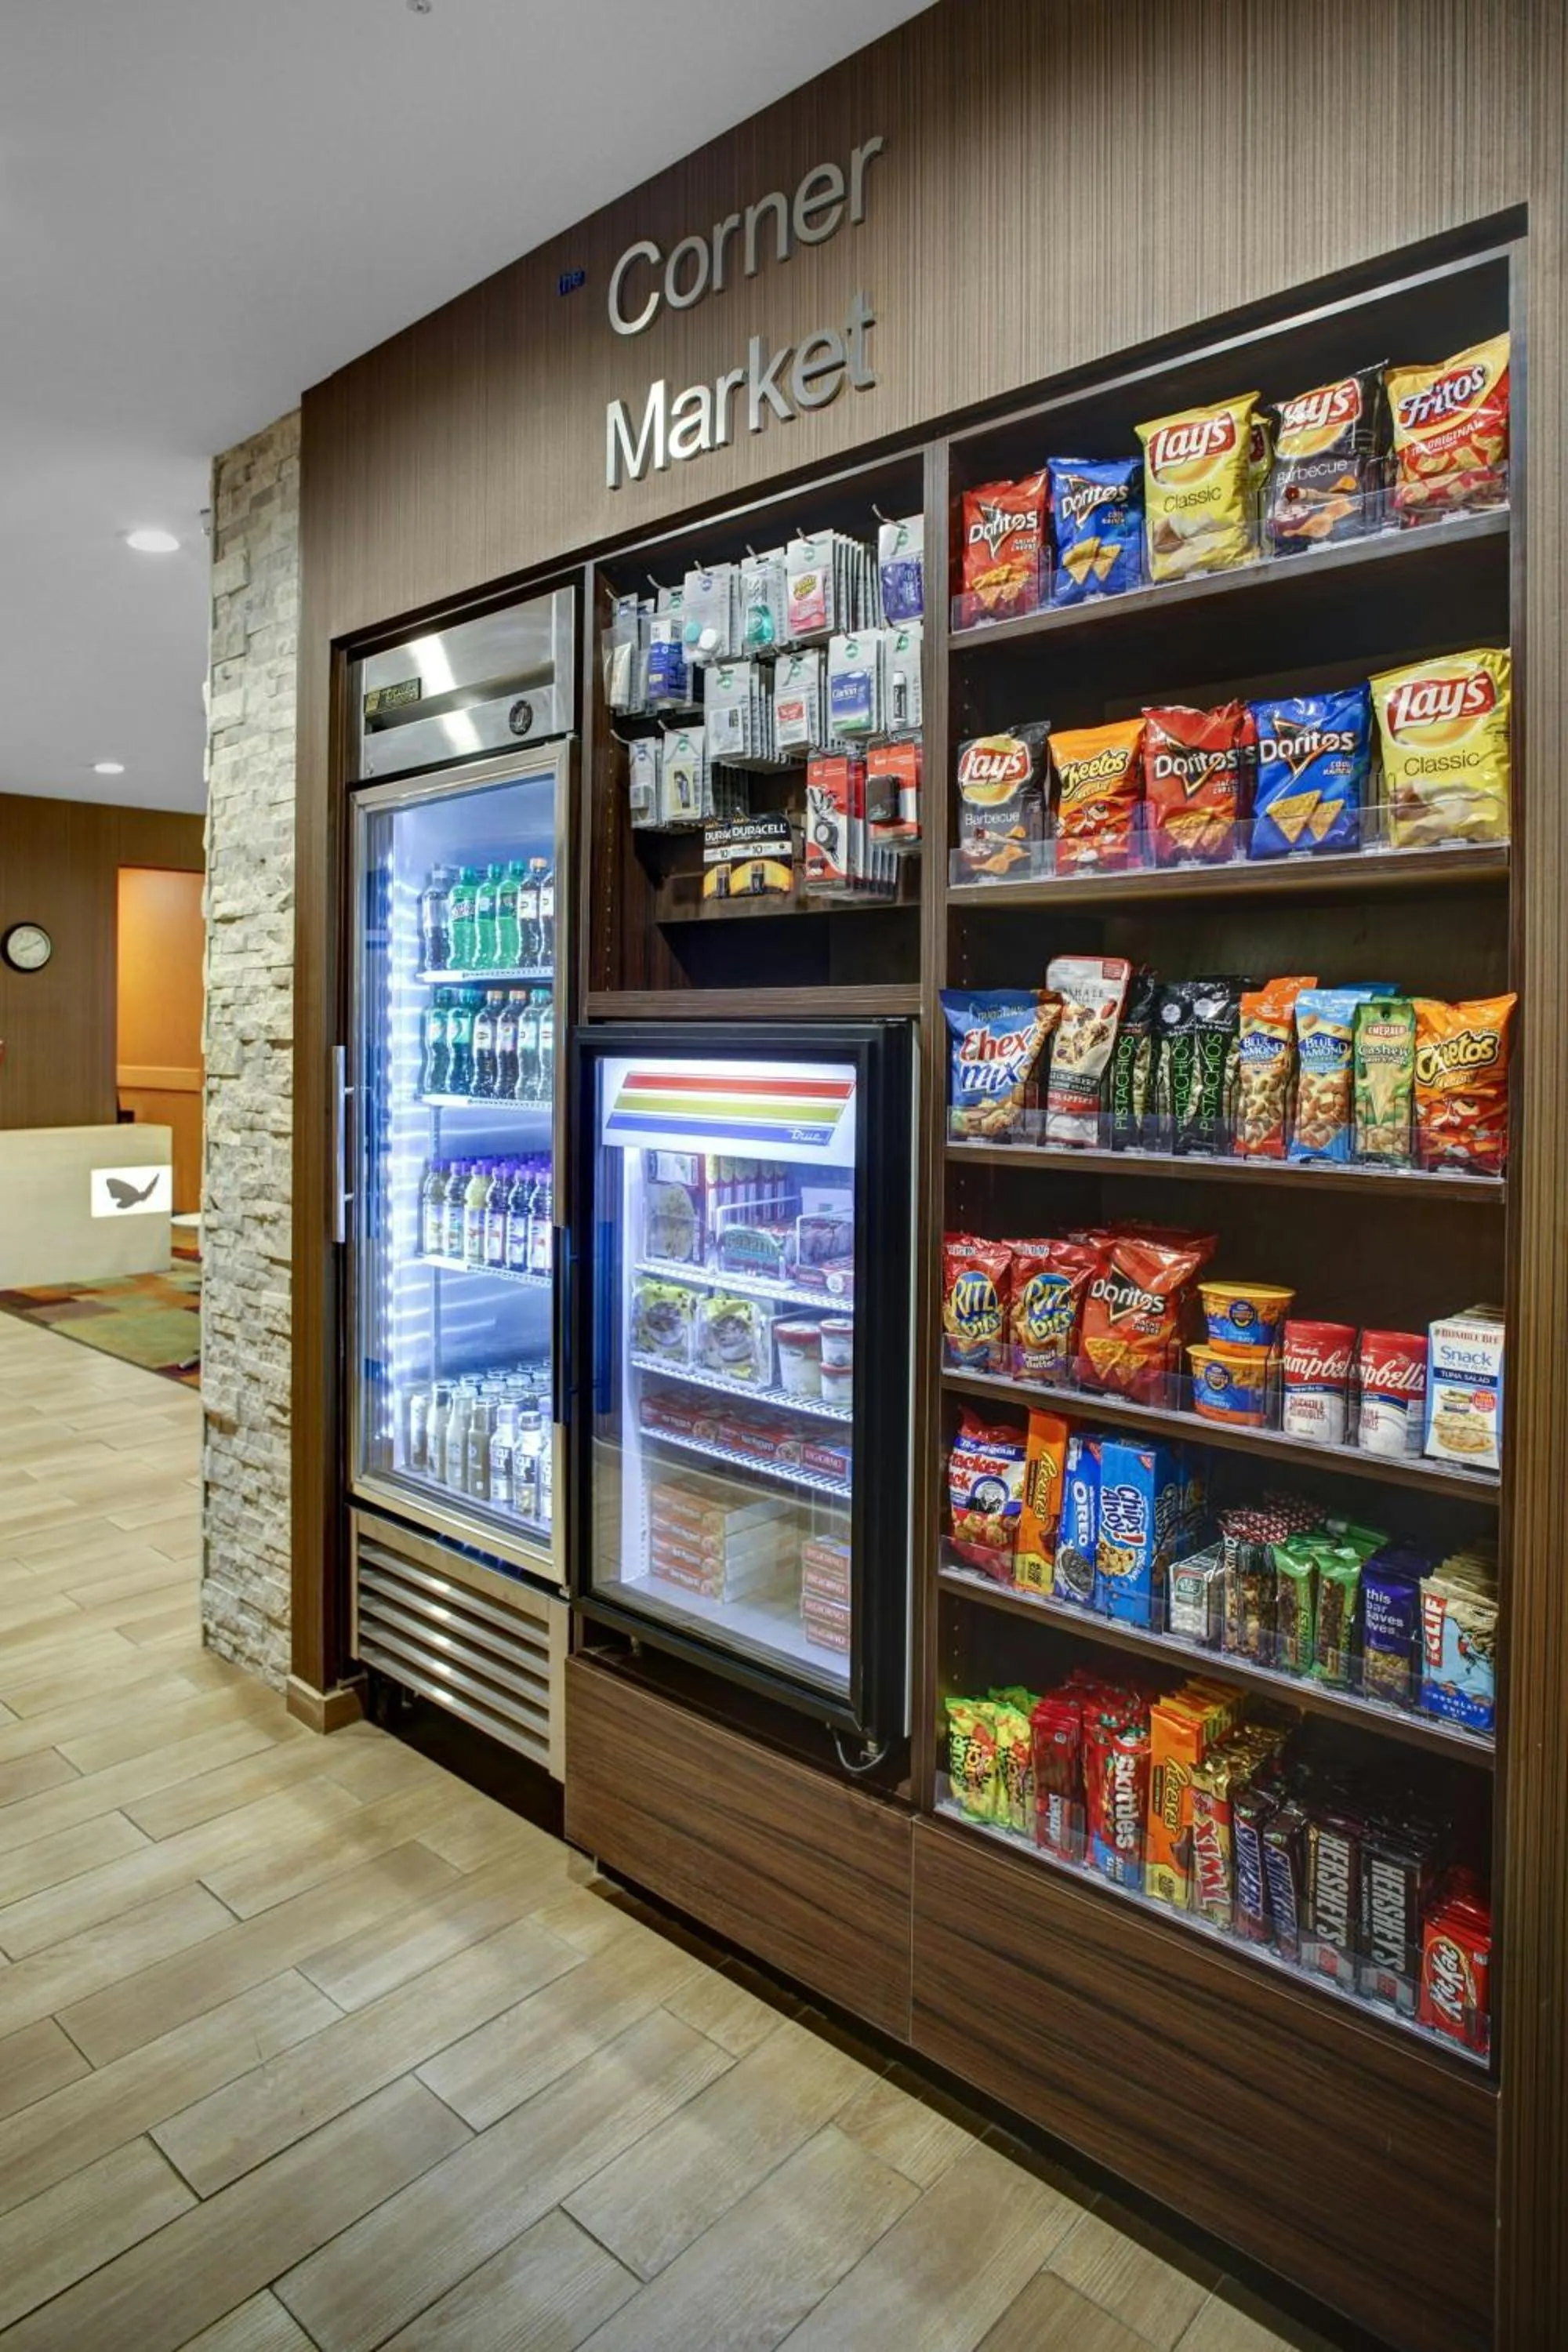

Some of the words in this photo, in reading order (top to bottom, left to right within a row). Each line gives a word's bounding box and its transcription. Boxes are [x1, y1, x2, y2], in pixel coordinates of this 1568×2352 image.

[607, 136, 884, 336] Corner
[605, 290, 876, 490] Market
[1399, 365, 1485, 429] Fritos
[1062, 485, 1129, 520] Doritos
[1163, 485, 1221, 513] Classic
[969, 508, 1037, 544] Doritos
[1155, 749, 1238, 779] Doritos
[1259, 731, 1355, 764] Doritos
[1404, 750, 1480, 776] Classic
[1061, 750, 1127, 799] Cheetos
[732, 822, 786, 837] DURACELL
[965, 812, 1020, 826] Barbecue
[960, 1027, 1031, 1062] Chex
[1114, 1036, 1134, 1131] PISTACHIOS
[1200, 1033, 1223, 1131] PISTACHIOS
[952, 1279, 993, 1318] RITZ
[1091, 1279, 1165, 1312] Doritos
[1441, 1328, 1479, 1341] BUMBLE
[1440, 1345, 1492, 1367] Snack
[1441, 1370, 1462, 1381] TUNA
[1464, 1374, 1491, 1385] SALAD
[1073, 1479, 1090, 1548] OREO
[1116, 1485, 1143, 1534] Chips
[1225, 1535, 1239, 1573] KIND
[1367, 1588, 1392, 1606] this
[1367, 1601, 1388, 1613] bar
[1367, 1610, 1404, 1628] saves
[1425, 1594, 1443, 1651] CLIF
[1113, 1752, 1139, 1849] Skittles
[1193, 1820, 1229, 1909] TWIX
[1316, 1831, 1349, 1947] HERSHEY'S
[1371, 1860, 1406, 1972] HERSHEY'S
